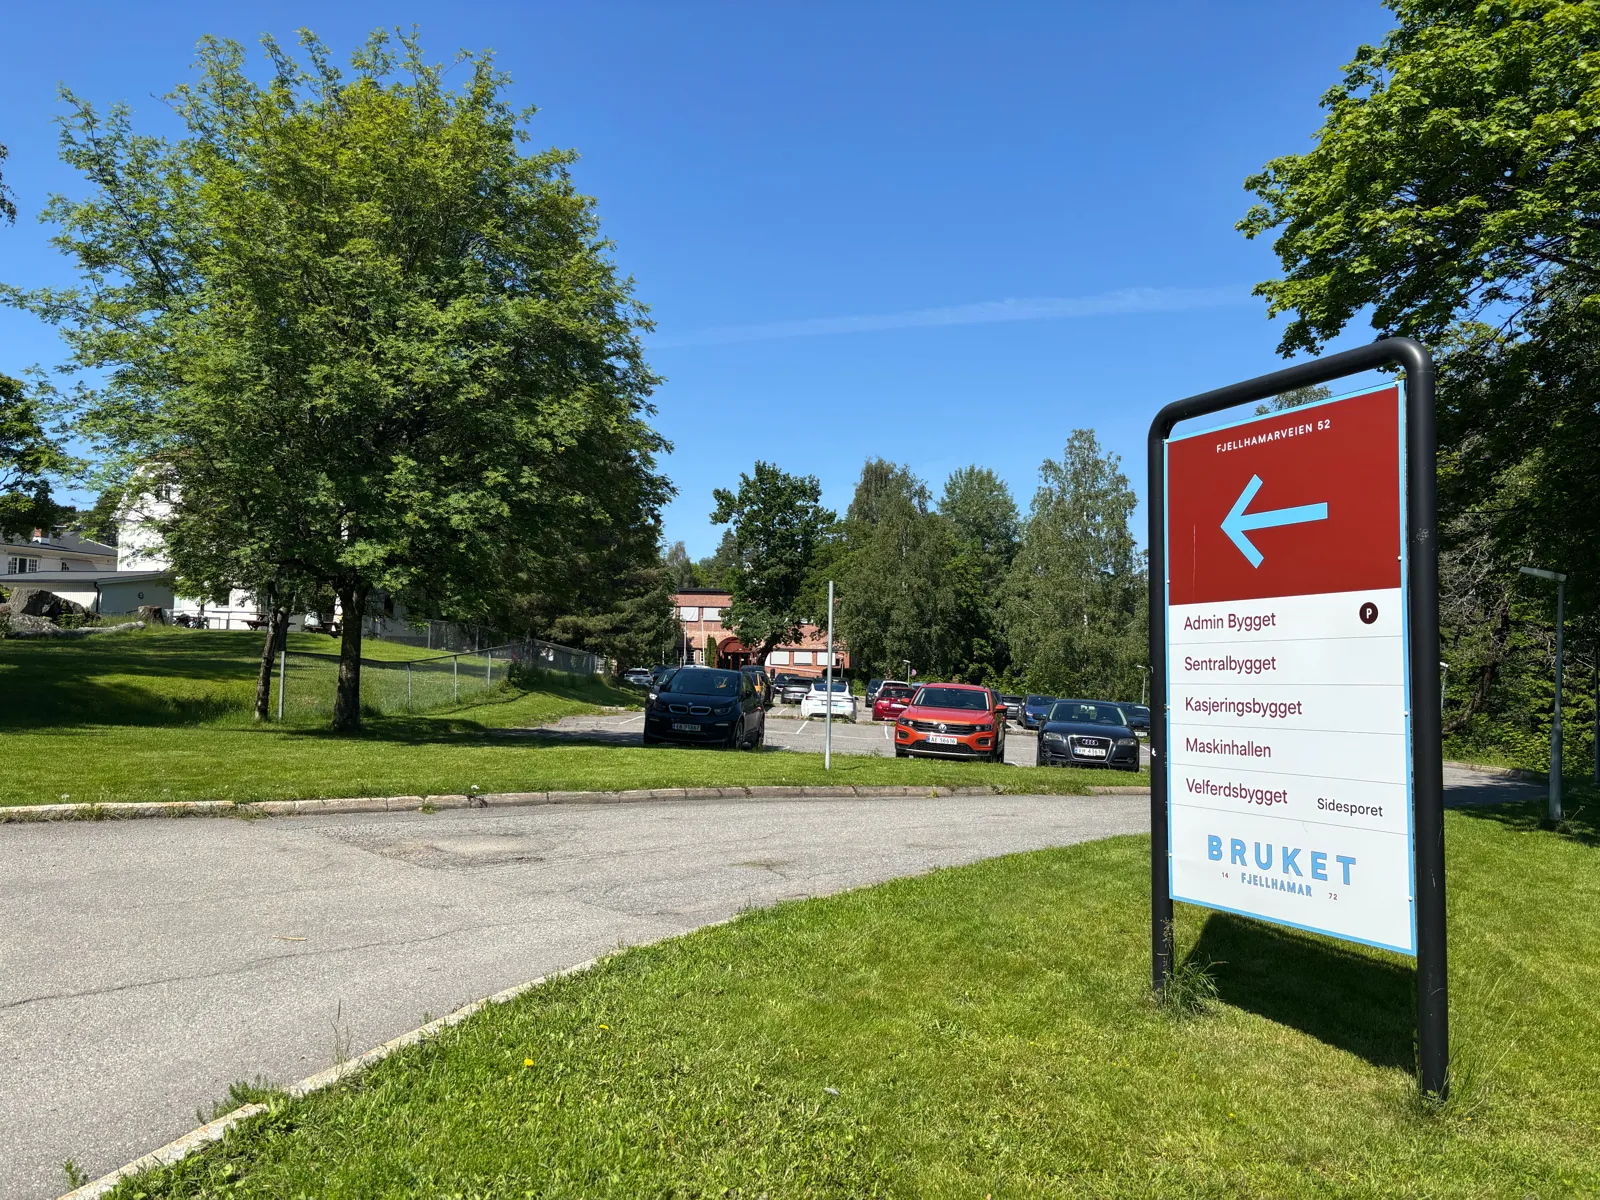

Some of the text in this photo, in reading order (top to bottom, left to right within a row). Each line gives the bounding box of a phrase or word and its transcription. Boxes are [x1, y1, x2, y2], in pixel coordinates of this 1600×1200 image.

[1216, 419, 1331, 454] FJELLHAMARVEIEN 52
[1184, 612, 1277, 632] Admin Bygget
[1184, 656, 1277, 675] Sentralbygget
[1185, 697, 1303, 719] Kasjeringsbygget
[1185, 737, 1272, 758] Maskinhallen
[1186, 778, 1288, 806] Velferdsbygget
[1317, 797, 1383, 818] Sidesporet
[1208, 834, 1356, 885] BRUKET
[1221, 871, 1338, 901] 14 FJELLHAMAR 72
